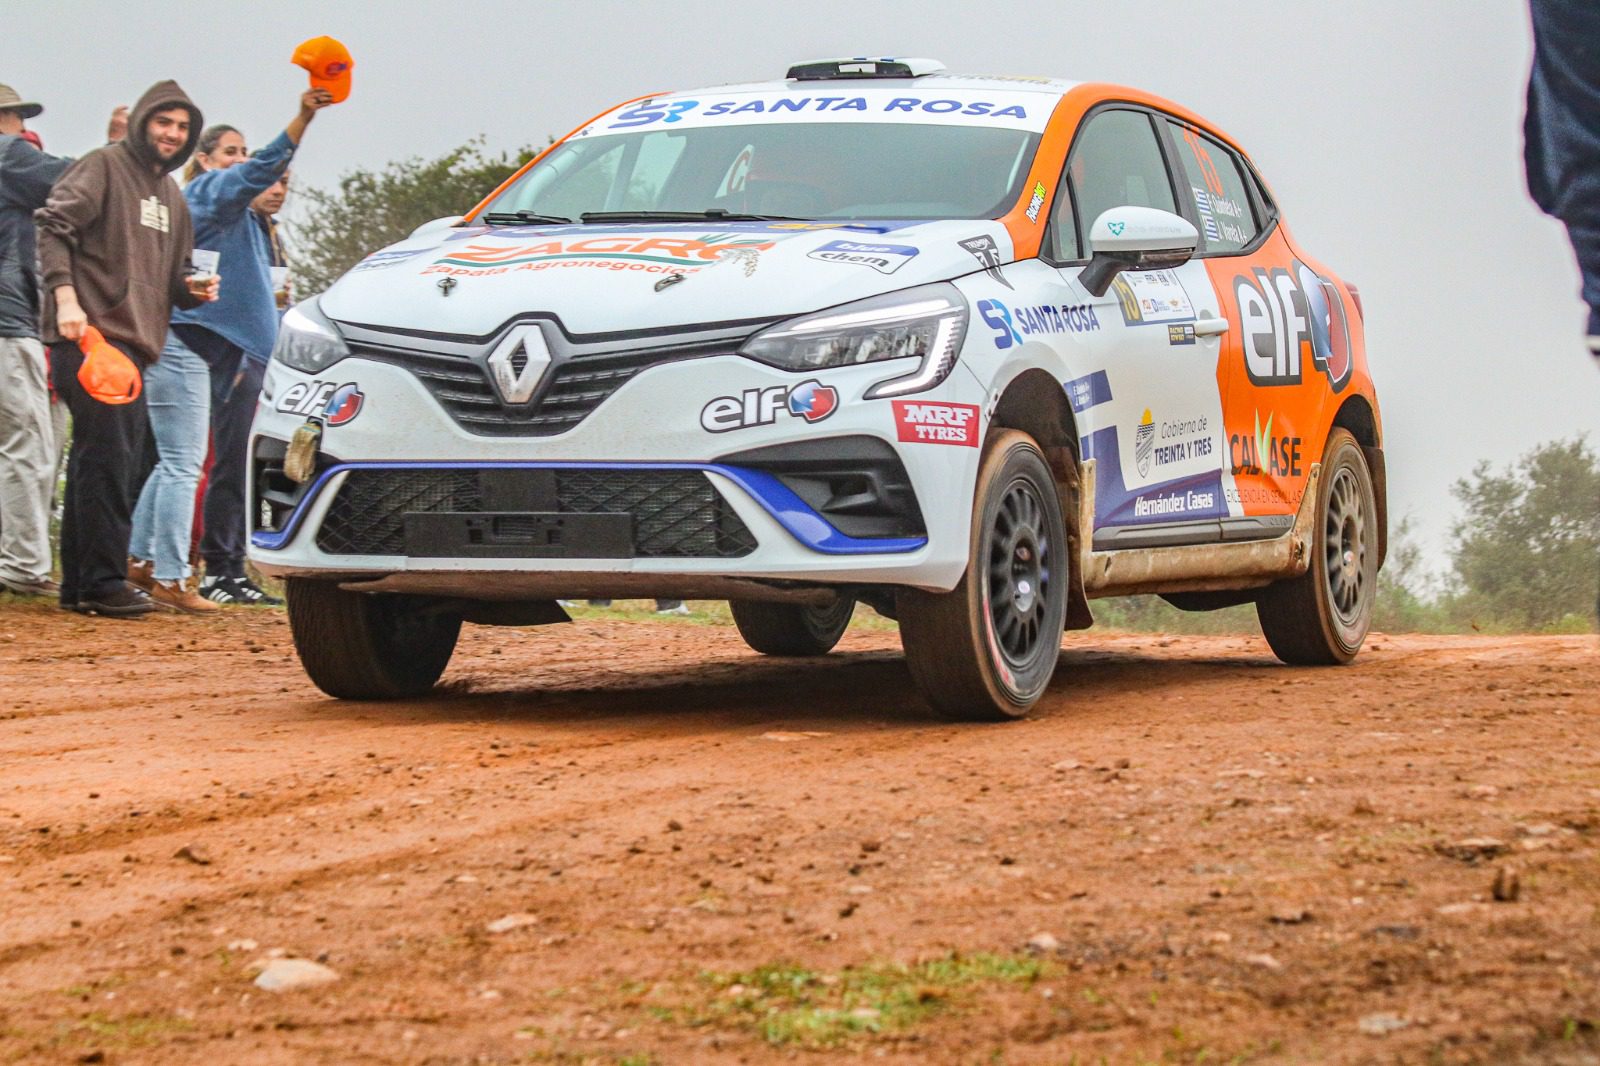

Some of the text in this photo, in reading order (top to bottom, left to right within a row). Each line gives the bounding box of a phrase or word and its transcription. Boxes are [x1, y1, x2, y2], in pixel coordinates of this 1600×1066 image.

[702, 97, 868, 117] SANTA
[883, 97, 1027, 119] ROSA
[820, 250, 890, 268] chem
[834, 242, 891, 253] blue
[419, 259, 701, 277] Zapata Agronegocios
[1014, 305, 1064, 335] SANTA
[1062, 304, 1101, 333] ROSA
[1235, 268, 1306, 386] elf
[276, 380, 338, 417] elf
[700, 384, 788, 433] elf
[903, 404, 974, 427] MRF
[1160, 414, 1208, 440] Gobierno de
[915, 425, 968, 442] TYRES
[1154, 436, 1212, 466] TREINTA Y TRES
[1134, 490, 1213, 516] Hernández Casas
